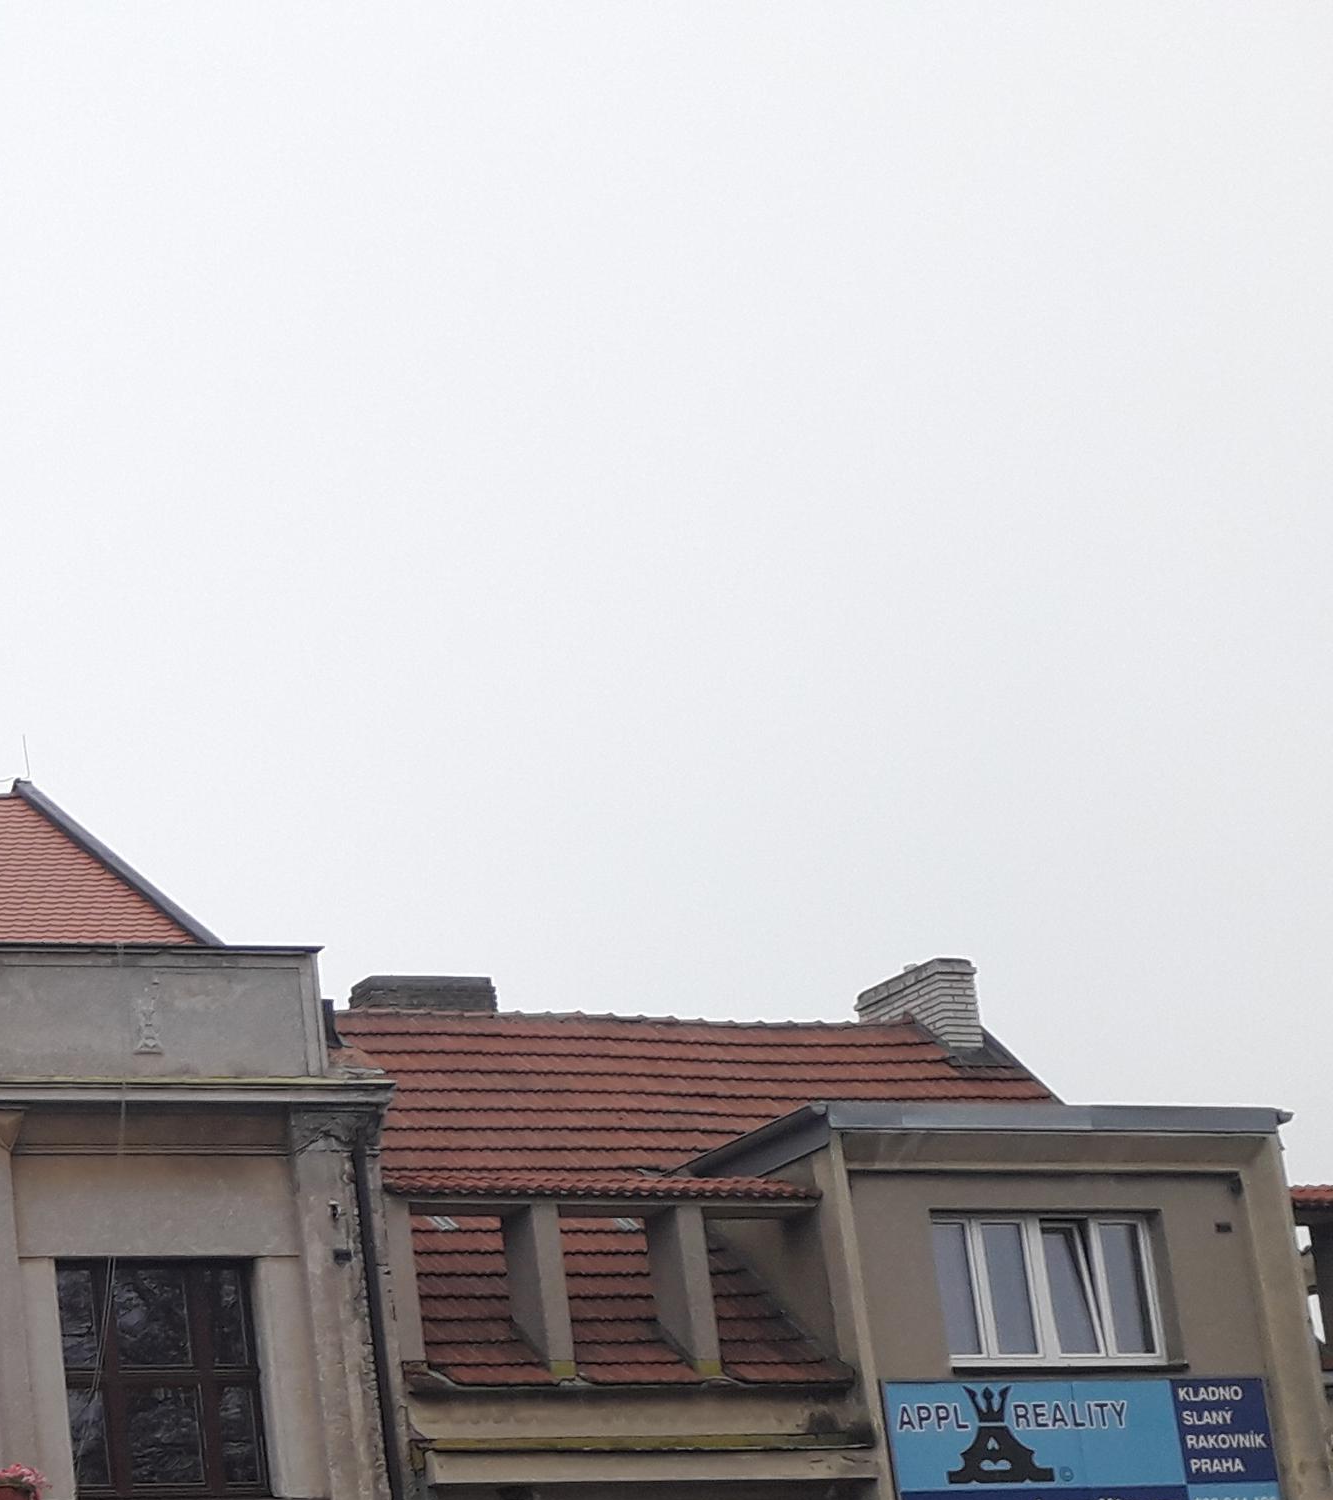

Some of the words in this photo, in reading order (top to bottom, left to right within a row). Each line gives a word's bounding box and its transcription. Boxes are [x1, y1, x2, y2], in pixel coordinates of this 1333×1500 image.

[1178, 1386, 1242, 1402] KLADNO
[897, 1404, 969, 1431] APPL
[1013, 1401, 1127, 1430] REALITY
[1182, 1406, 1234, 1425] SLANÝ
[1186, 1432, 1267, 1450] RAKOVNÍK
[1190, 1458, 1244, 1474] PRAHA
